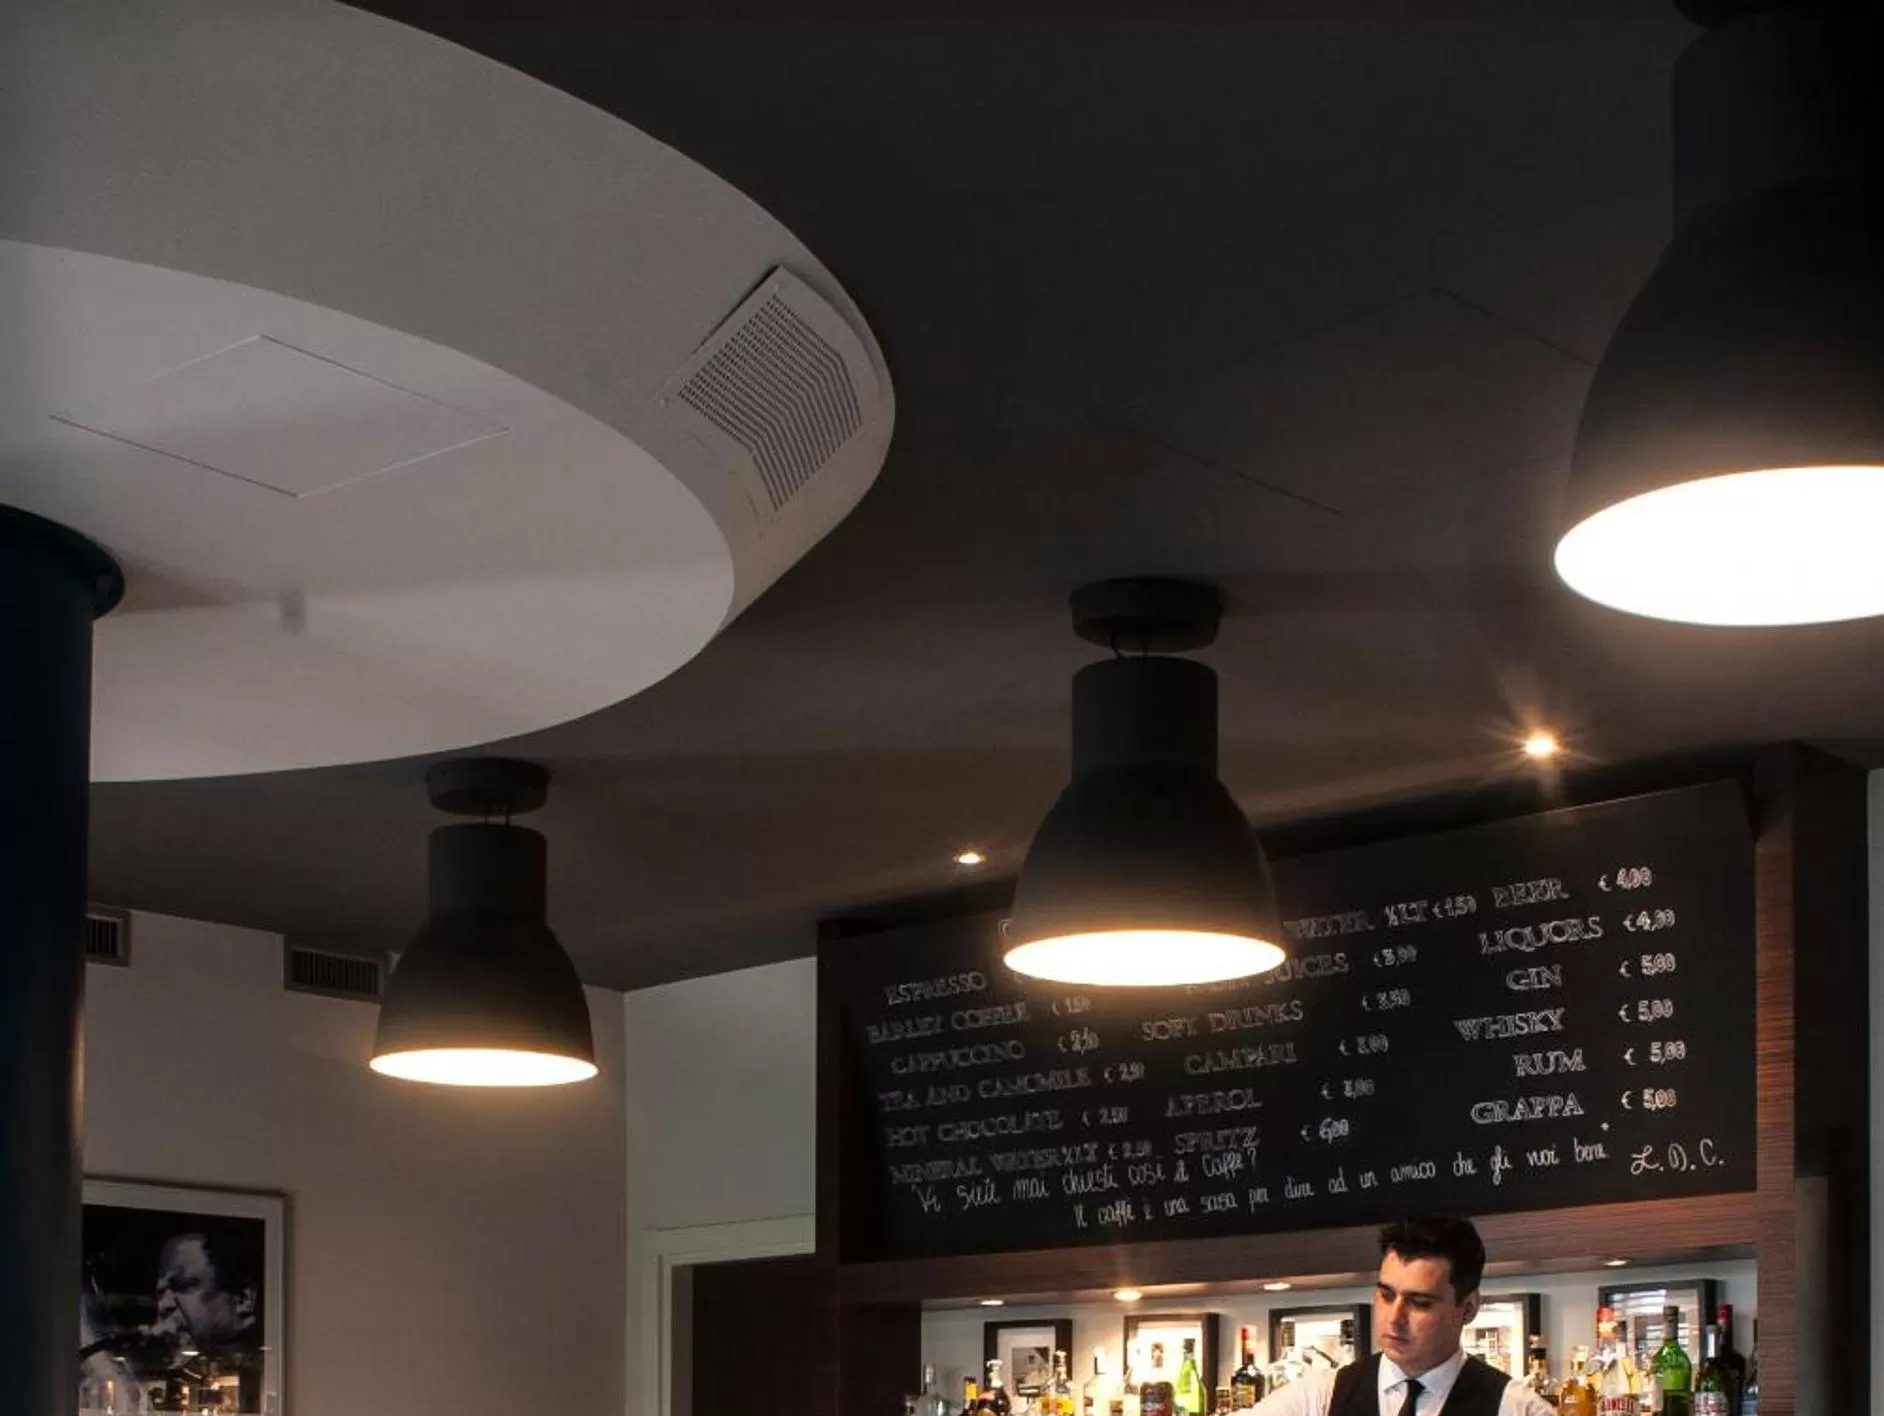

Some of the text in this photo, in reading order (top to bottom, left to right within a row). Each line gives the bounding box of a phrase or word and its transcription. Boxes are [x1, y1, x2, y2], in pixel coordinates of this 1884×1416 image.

[1479, 915, 1604, 956] LIQUORS
[885, 971, 987, 1006] ESPRESSO
[1506, 964, 1563, 991] GIN
[1141, 1017, 1199, 1043] SOFT
[1208, 999, 1304, 1033] DRINKS
[1453, 1007, 1566, 1042] WHISKY
[1512, 1048, 1587, 1077] RUM
[926, 1083, 972, 1107] AND
[1165, 1086, 1263, 1117] APEROL
[1469, 1091, 1585, 1125] GRAPPA
